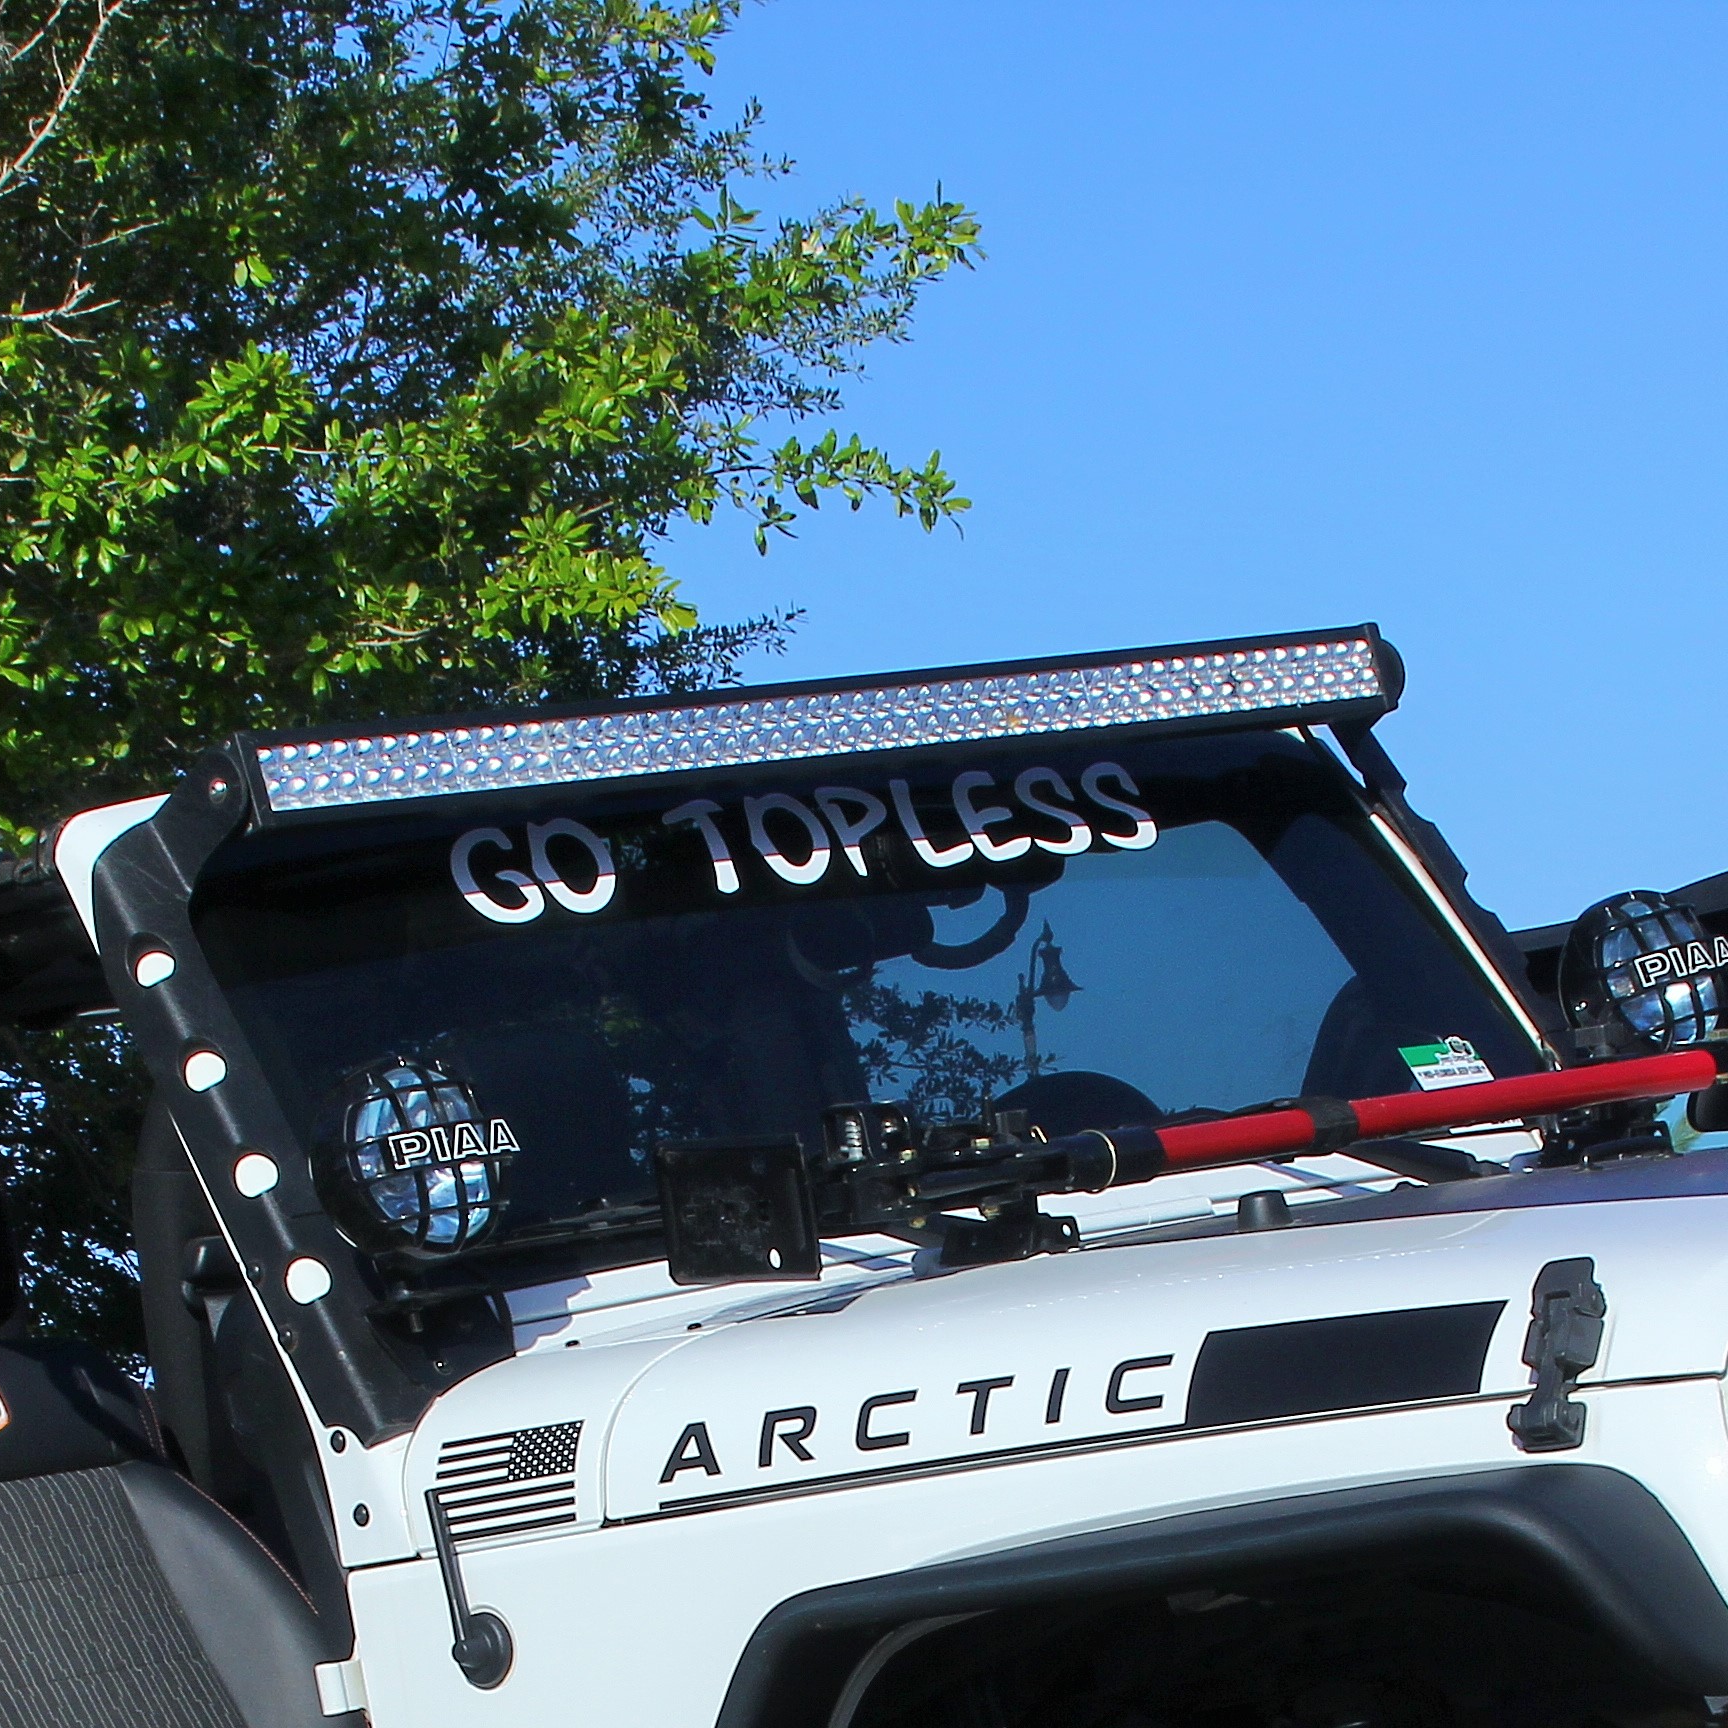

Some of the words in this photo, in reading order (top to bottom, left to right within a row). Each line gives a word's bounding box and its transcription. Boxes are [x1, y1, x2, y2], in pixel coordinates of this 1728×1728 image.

[449, 820, 617, 924] GO
[663, 762, 1158, 893] TOPLESS
[387, 1118, 520, 1170] PIAA
[658, 1353, 1174, 1485] ARCTIC
